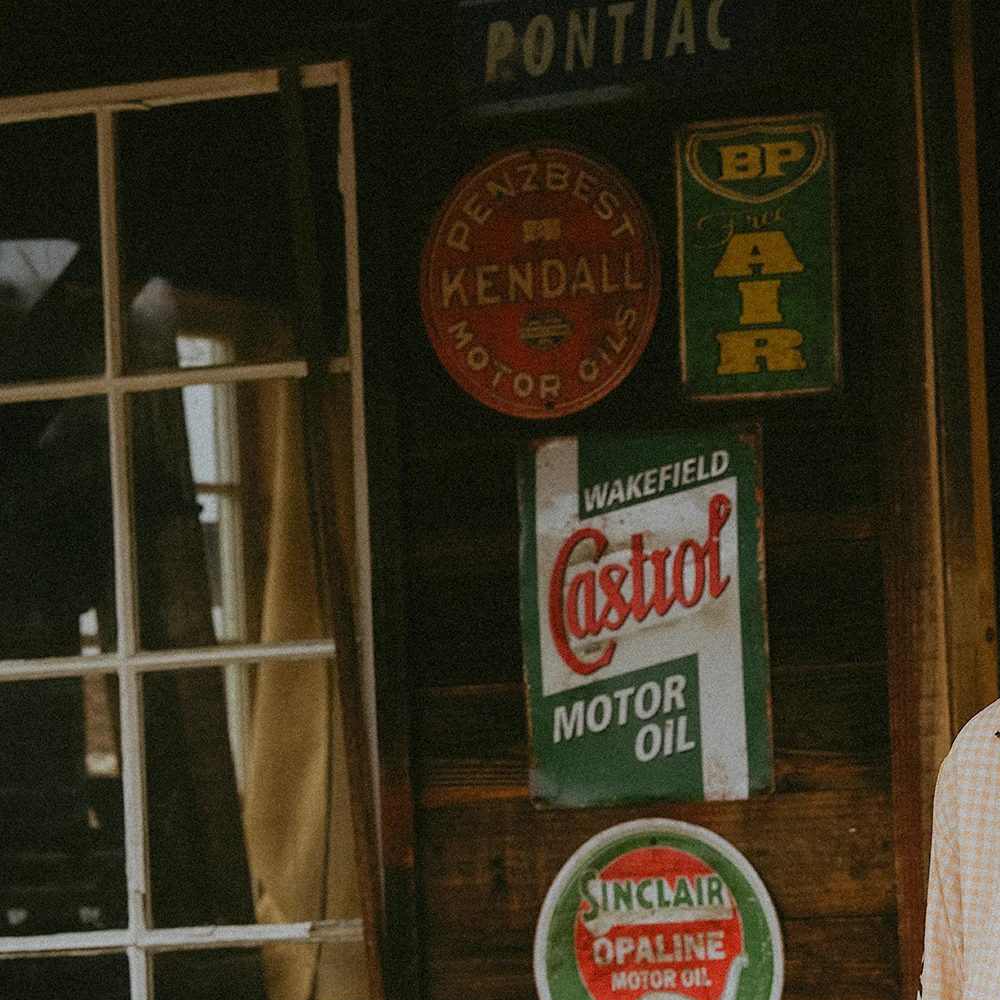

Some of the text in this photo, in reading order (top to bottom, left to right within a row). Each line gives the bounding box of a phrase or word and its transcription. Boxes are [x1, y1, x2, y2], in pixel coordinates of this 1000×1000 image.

[485, 0, 731, 83] PONTIAC
[717, 140, 805, 181] BP
[446, 162, 634, 252] PENZBEST
[441, 252, 643, 308] KENDALL
[714, 231, 806, 374] AIR
[449, 319, 561, 398] MOTOR
[579, 305, 637, 382] OILS
[584, 450, 729, 512] WAKEFIELD
[548, 494, 731, 675] Castrol
[553, 675, 686, 743] MOTOR
[635, 715, 696, 762] OIL
[579, 869, 724, 921] SINCLAIR
[593, 932, 726, 965] OPALINE
[612, 967, 713, 991] MOTOR OIL
